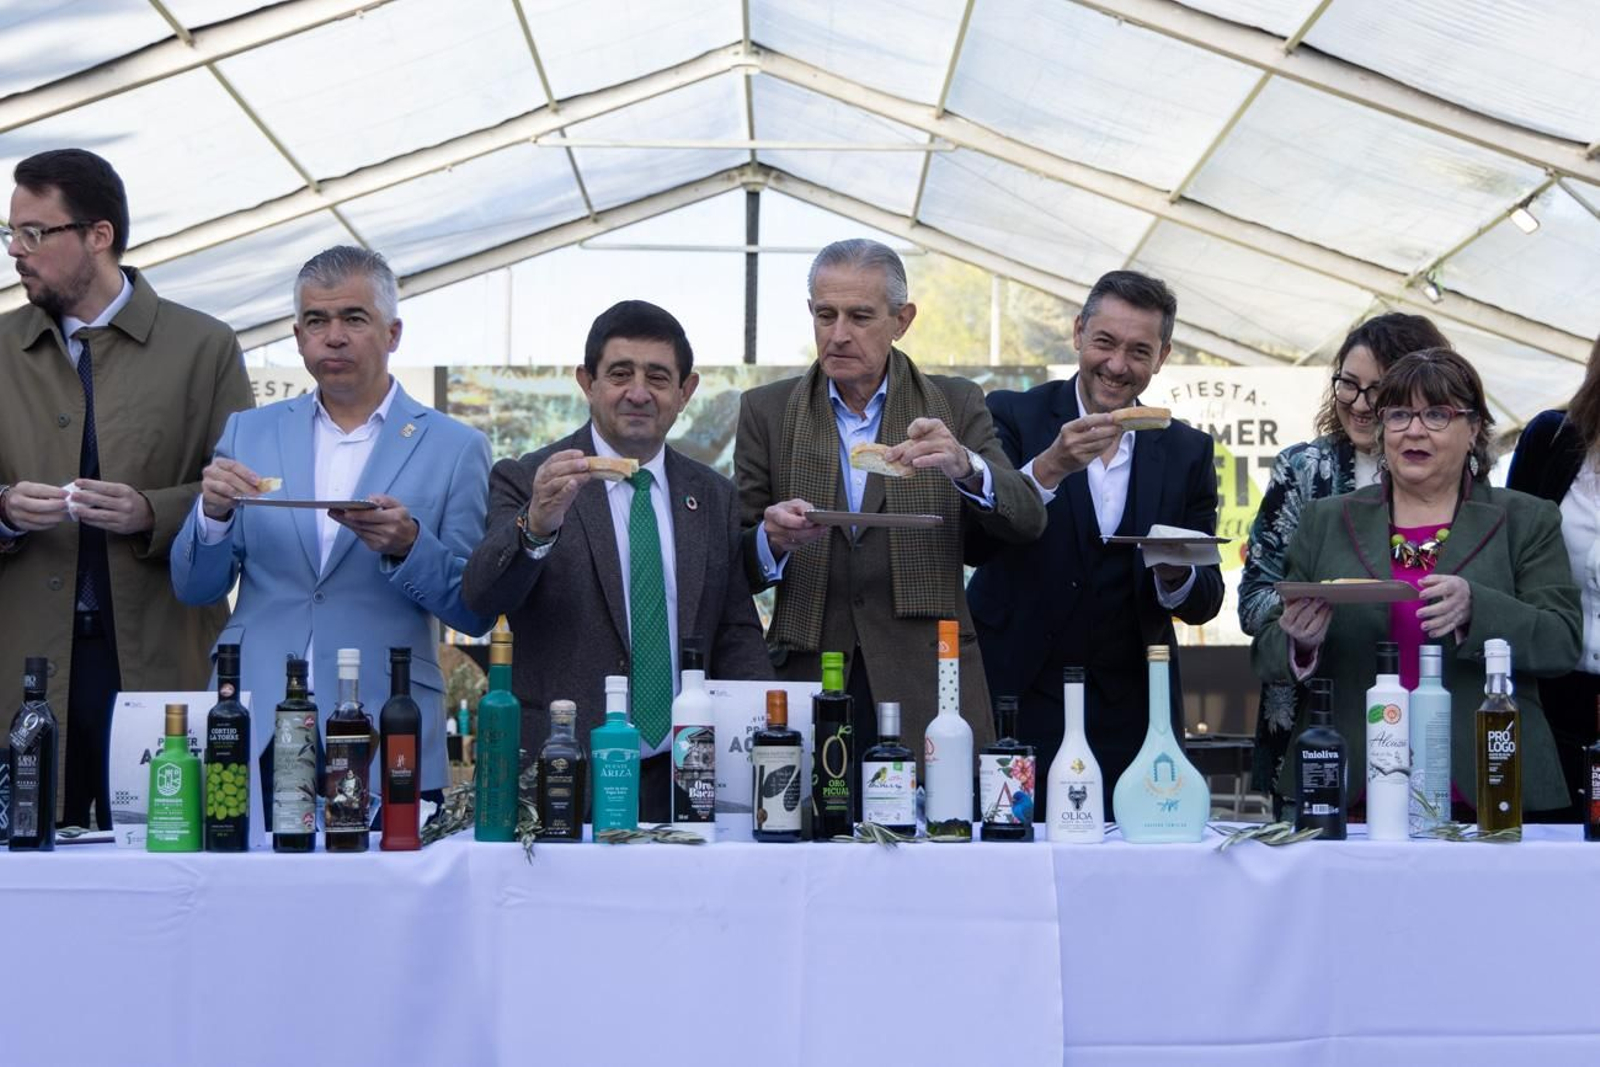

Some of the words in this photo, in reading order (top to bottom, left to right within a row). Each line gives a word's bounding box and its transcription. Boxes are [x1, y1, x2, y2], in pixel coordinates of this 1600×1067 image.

[1488, 741, 1516, 753] LOGO
[1302, 750, 1339, 759] Unioliva
[600, 768, 632, 777] ARIZA
[823, 787, 849, 796] PICUAL
